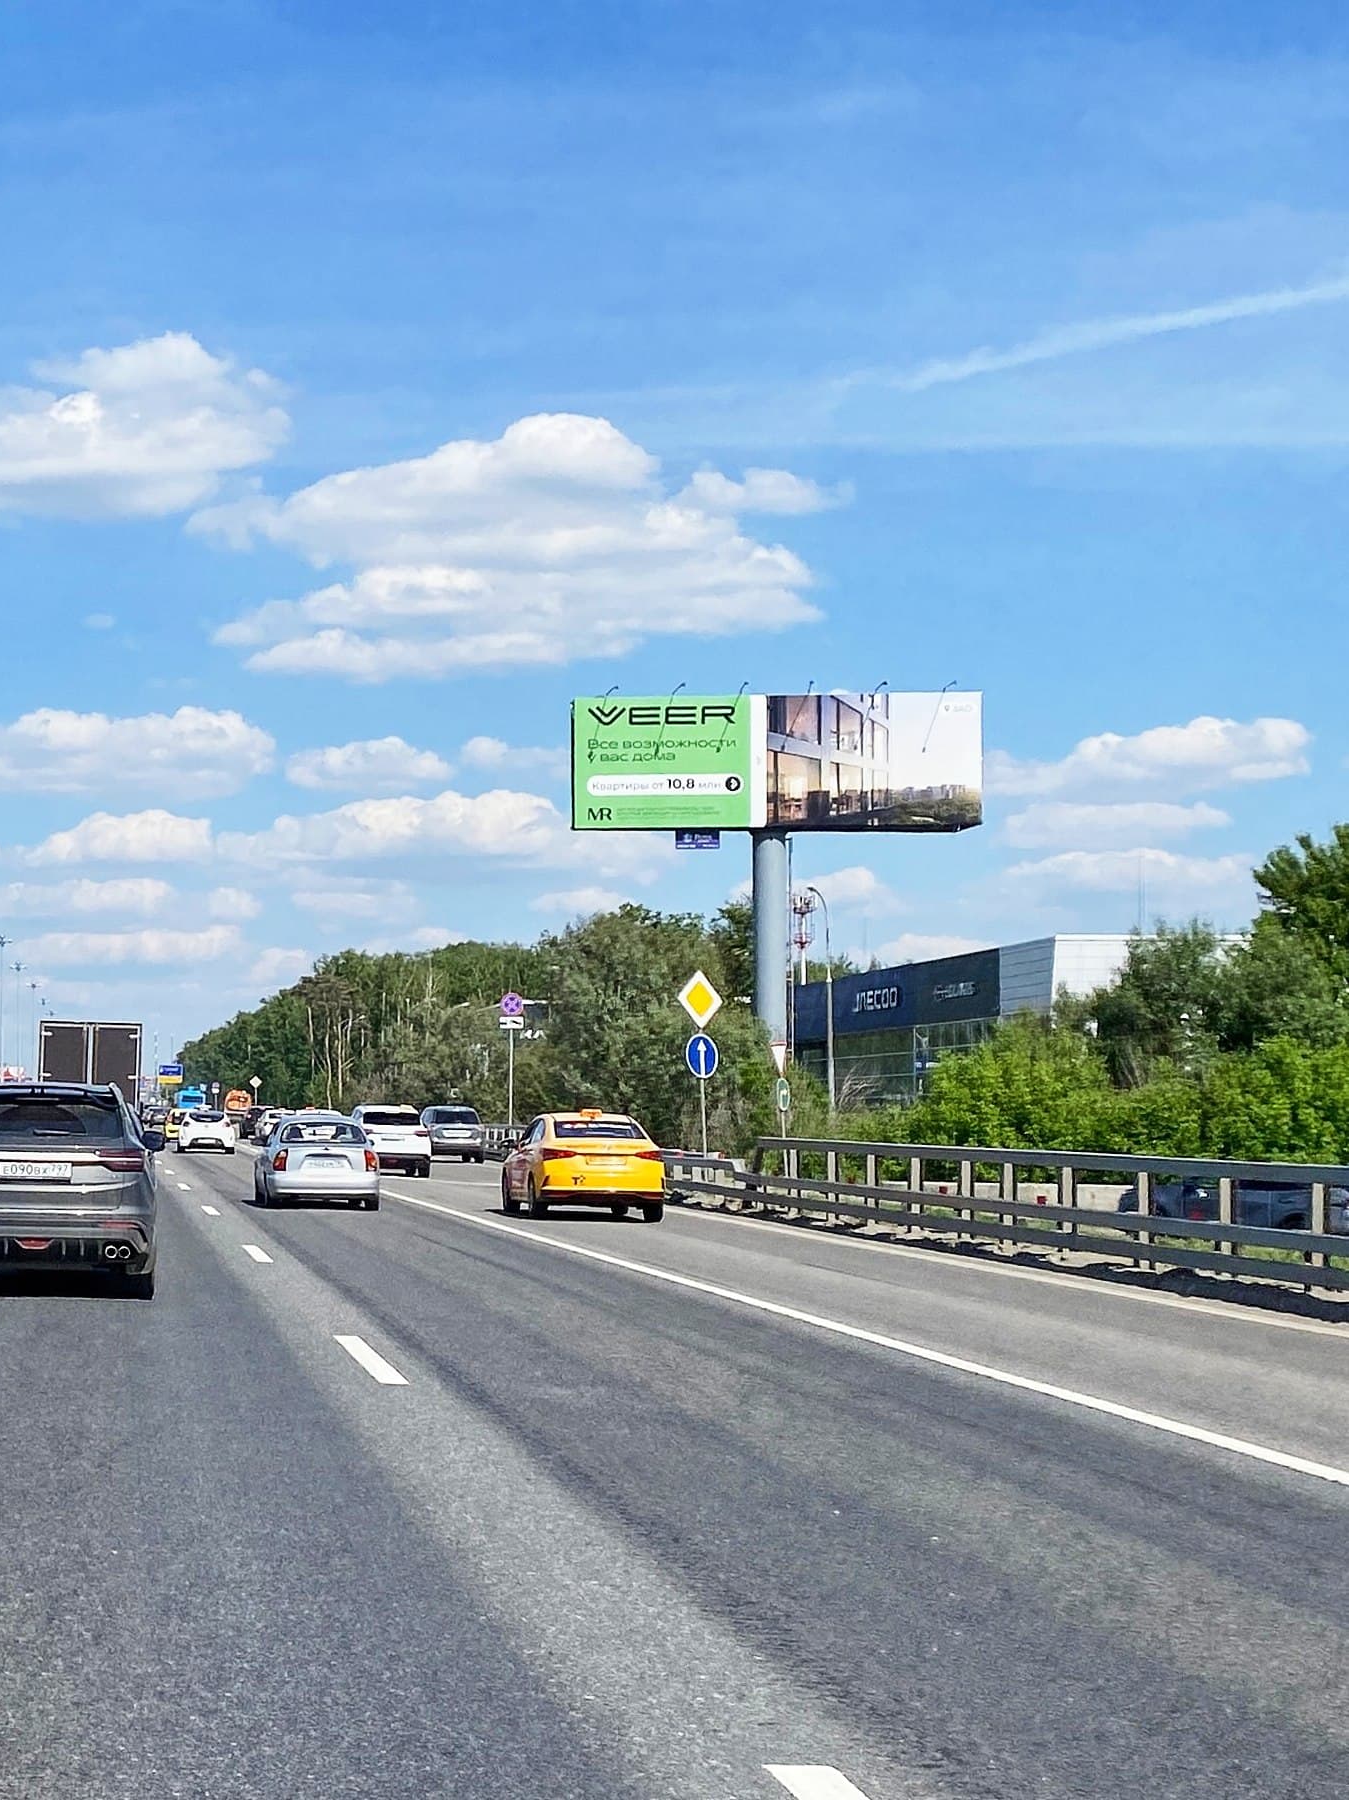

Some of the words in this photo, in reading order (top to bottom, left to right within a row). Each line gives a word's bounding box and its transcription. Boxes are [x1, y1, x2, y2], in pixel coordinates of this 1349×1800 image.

[588, 739, 618, 749] Все
[623, 738, 736, 750] возможности
[600, 753, 629, 762] вас
[633, 752, 676, 763] дома
[592, 782, 649, 791] Квартиры
[652, 782, 664, 790] от
[667, 778, 695, 791] 10,8
[587, 807, 612, 821] MR
